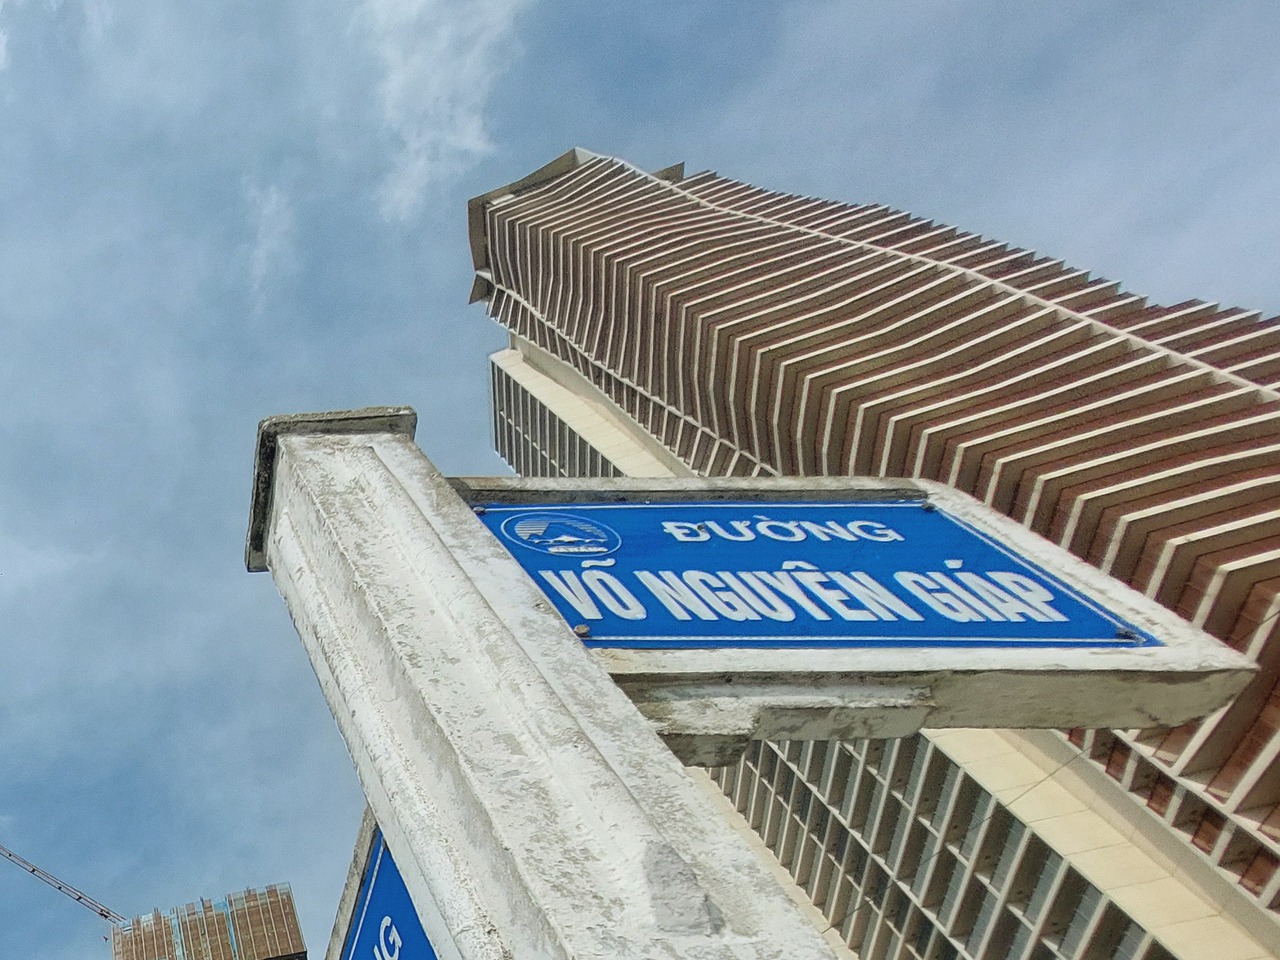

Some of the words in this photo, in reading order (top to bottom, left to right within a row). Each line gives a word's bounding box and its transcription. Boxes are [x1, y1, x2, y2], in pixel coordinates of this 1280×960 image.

[661, 515, 906, 542] ĐƯỜNG
[538, 558, 647, 620] VÕ
[633, 560, 925, 622] NGUYÊN
[893, 559, 1070, 622] GIÁP
